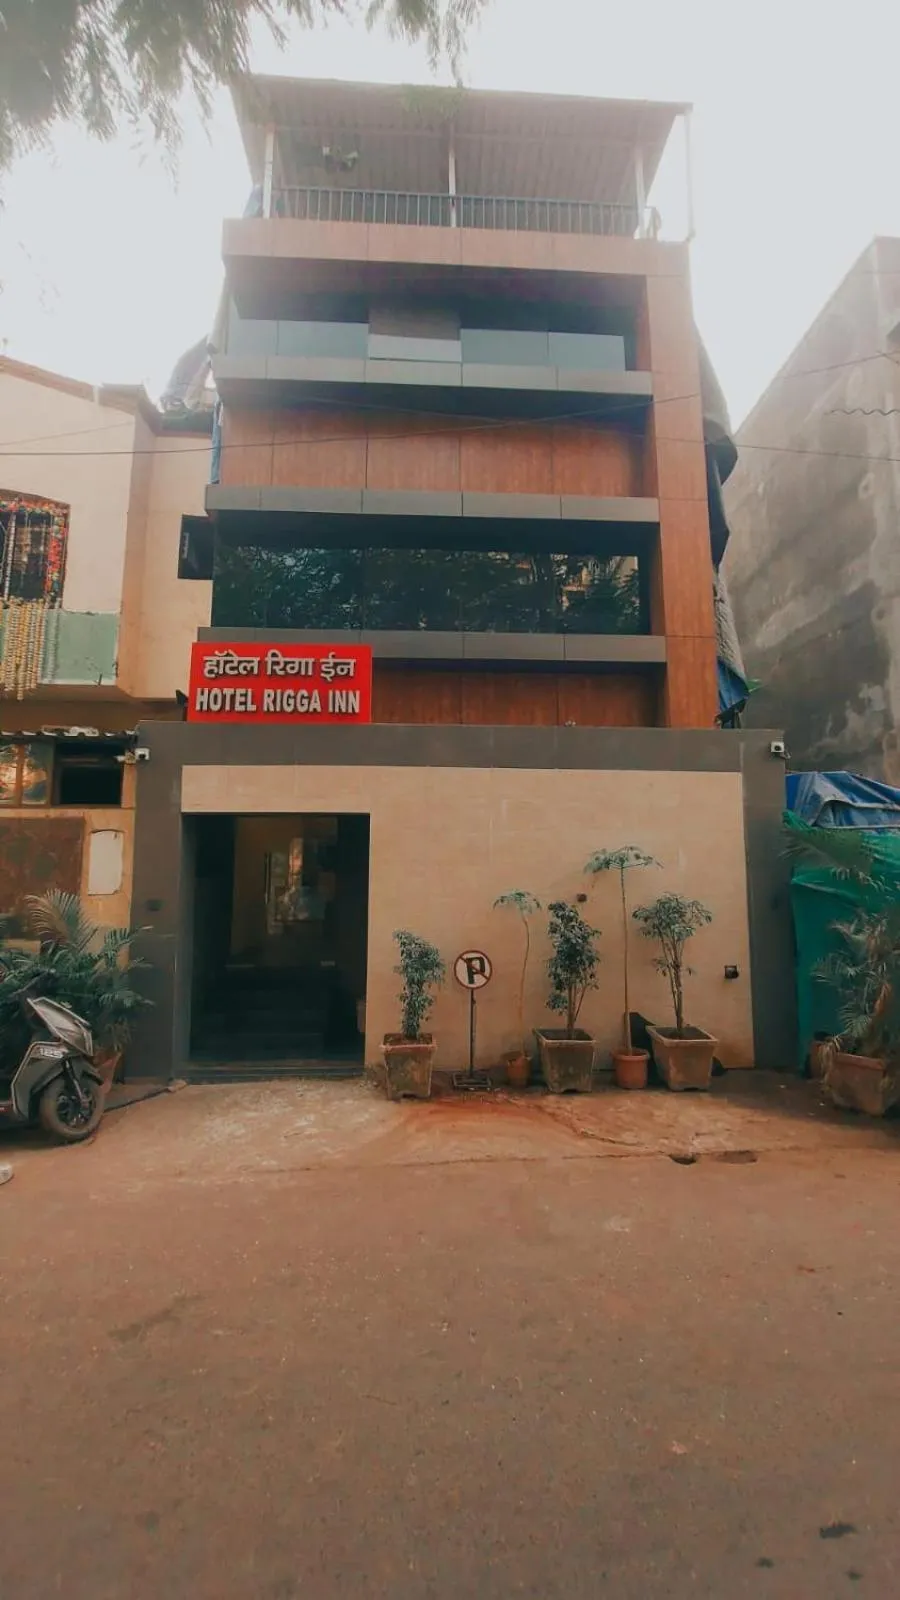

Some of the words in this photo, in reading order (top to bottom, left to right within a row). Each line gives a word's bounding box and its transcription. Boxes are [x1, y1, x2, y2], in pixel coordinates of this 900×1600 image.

[203, 650, 260, 678] हॉटेल
[265, 649, 315, 676] रिगा
[320, 652, 357, 682] ईन
[195, 687, 257, 712] HOTEL
[263, 689, 321, 713] RIGGA
[328, 690, 361, 714] INN
